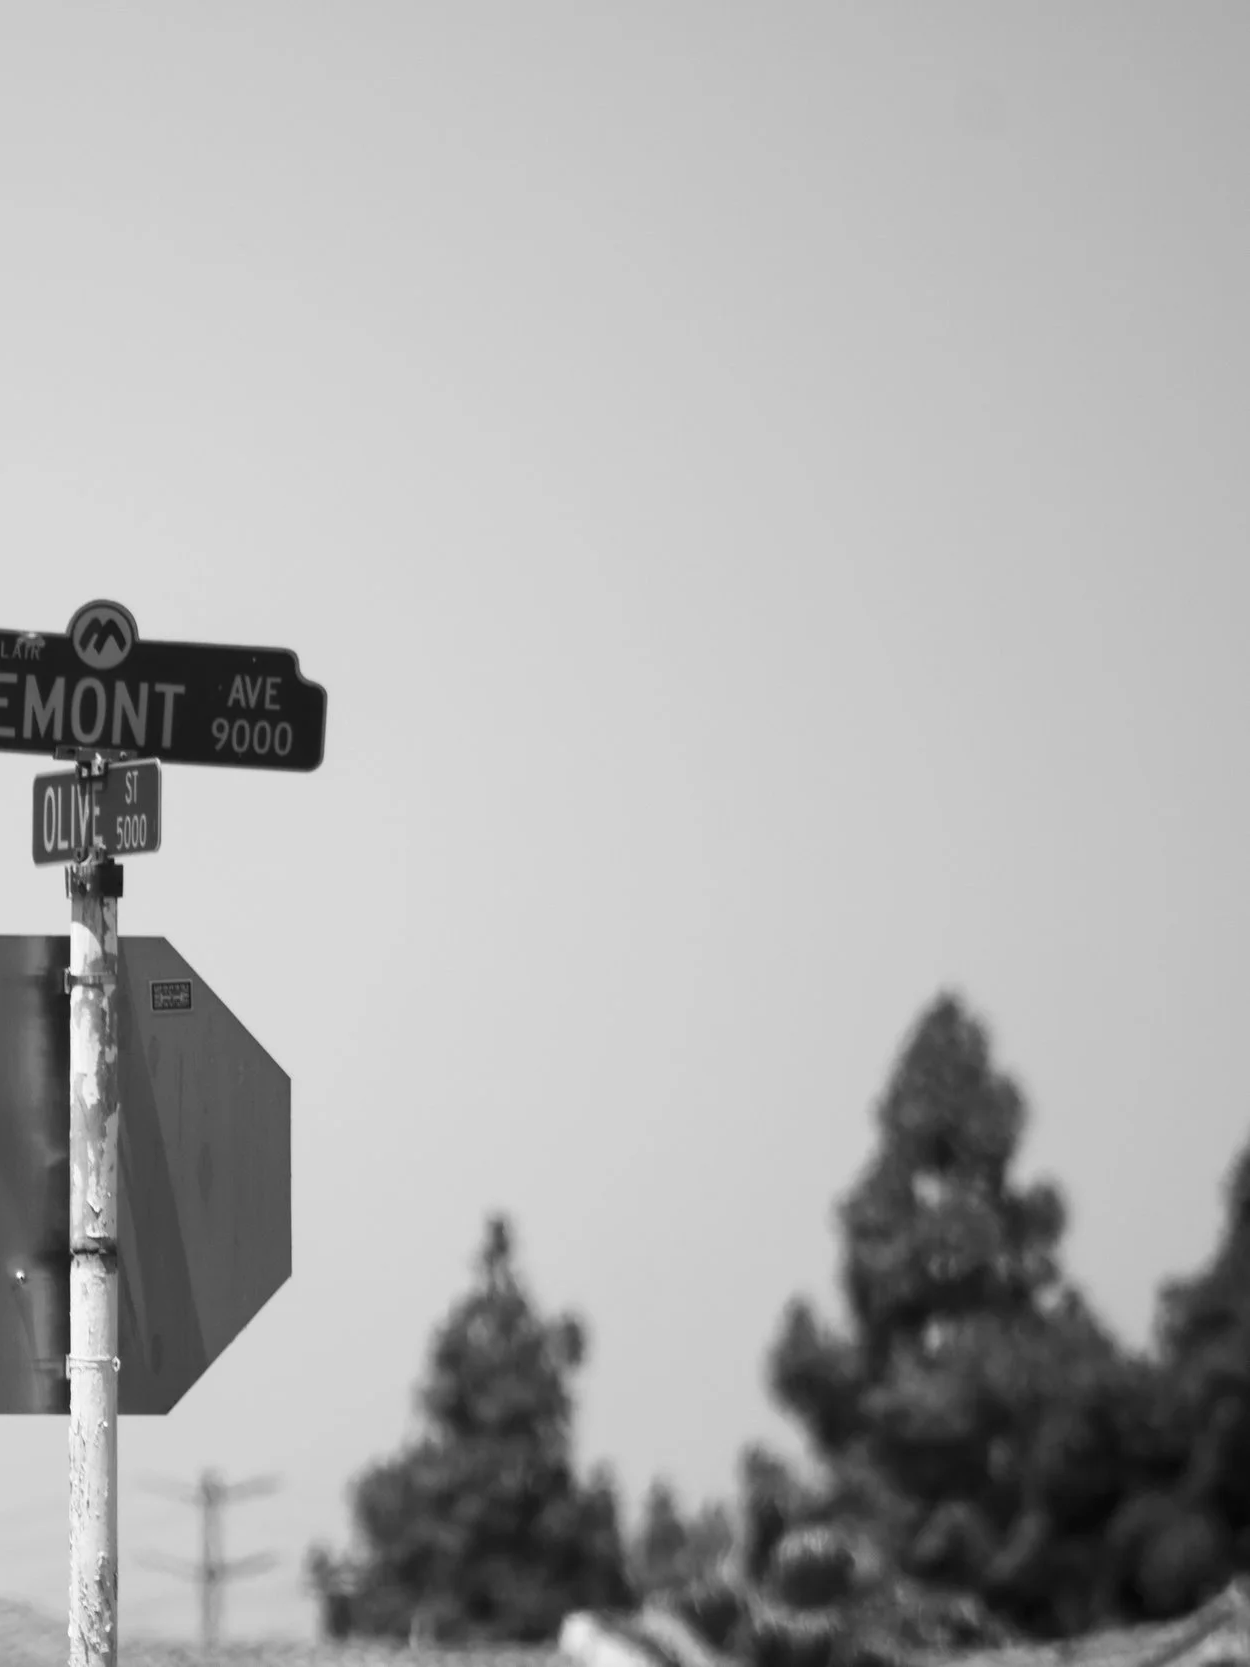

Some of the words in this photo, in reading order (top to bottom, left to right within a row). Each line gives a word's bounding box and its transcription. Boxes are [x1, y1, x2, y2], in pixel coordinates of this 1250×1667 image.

[227, 675, 282, 711] AVE
[210, 719, 293, 756] 9000
[43, 782, 104, 853] OLIVE
[125, 770, 139, 805] ST
[116, 813, 148, 850] 5000
